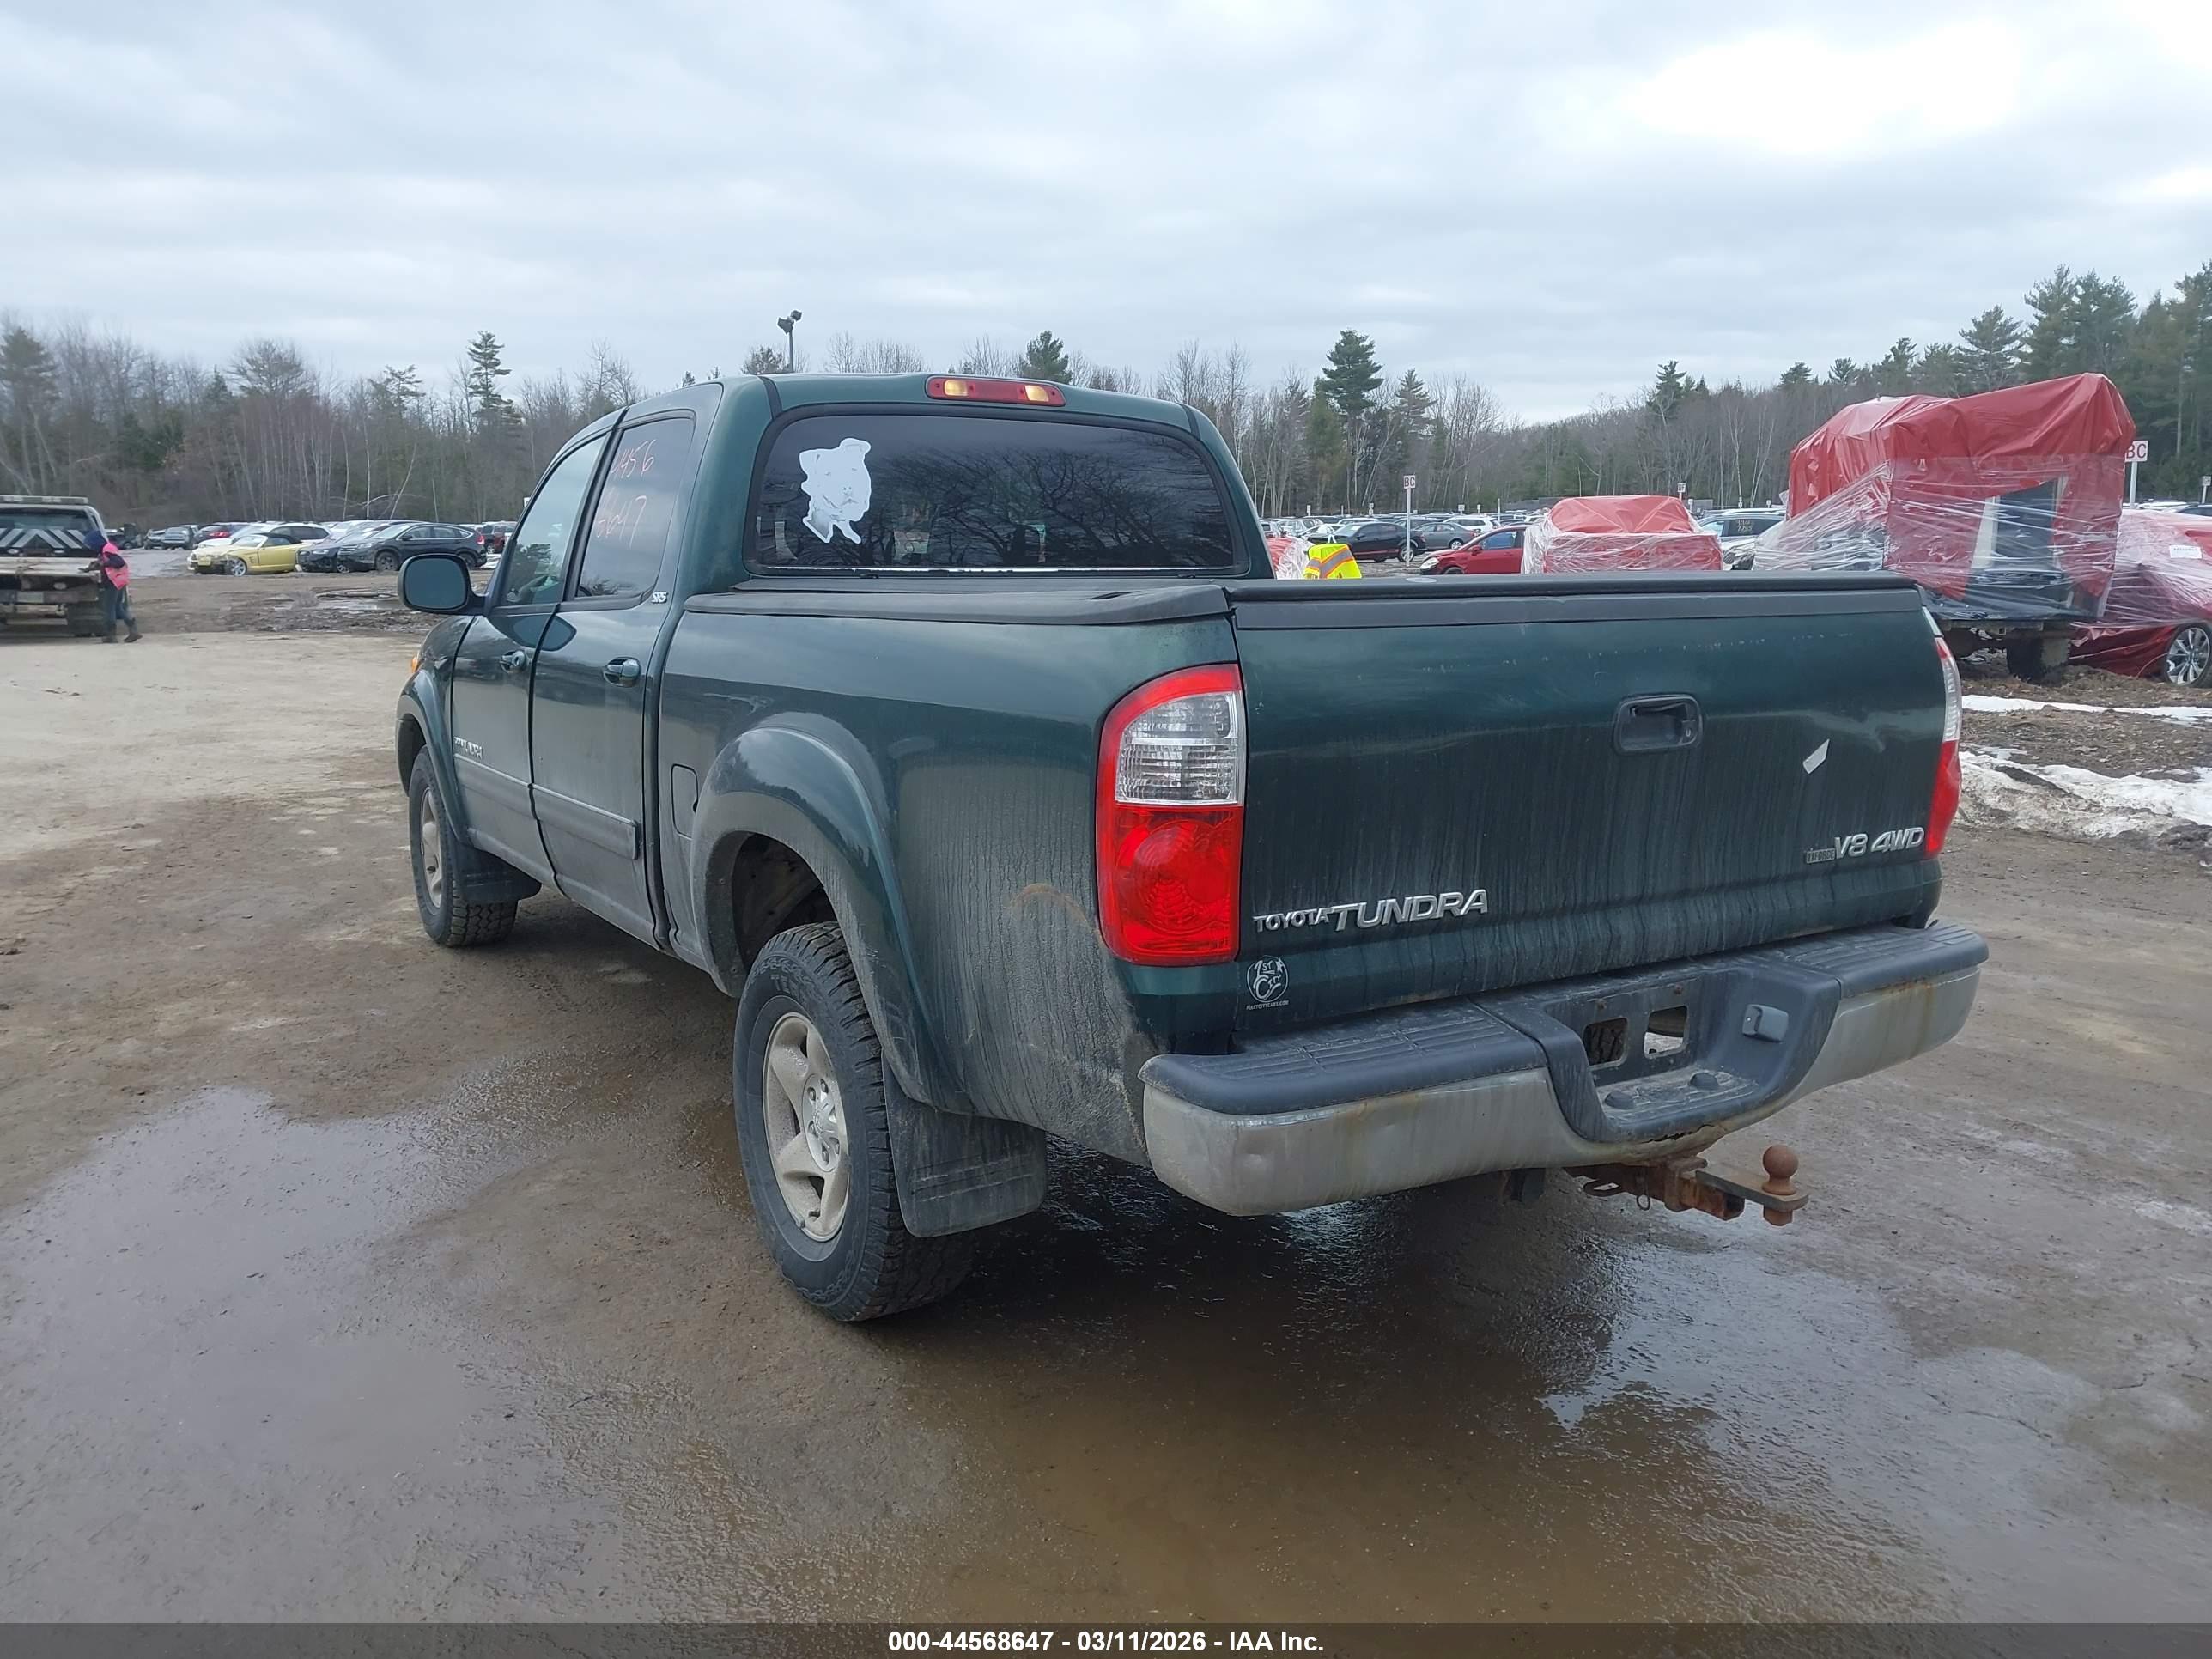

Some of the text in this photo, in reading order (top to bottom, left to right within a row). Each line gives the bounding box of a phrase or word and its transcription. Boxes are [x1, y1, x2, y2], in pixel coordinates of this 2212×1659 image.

[2125, 443, 2147, 459] BC
[1404, 477, 1415, 487] BC
[652, 592, 667, 603] SR5
[1834, 834, 1868, 859] V8
[1870, 827, 1924, 853] 4WD
[1253, 889, 1487, 933] TOYOTA TUNDRA
